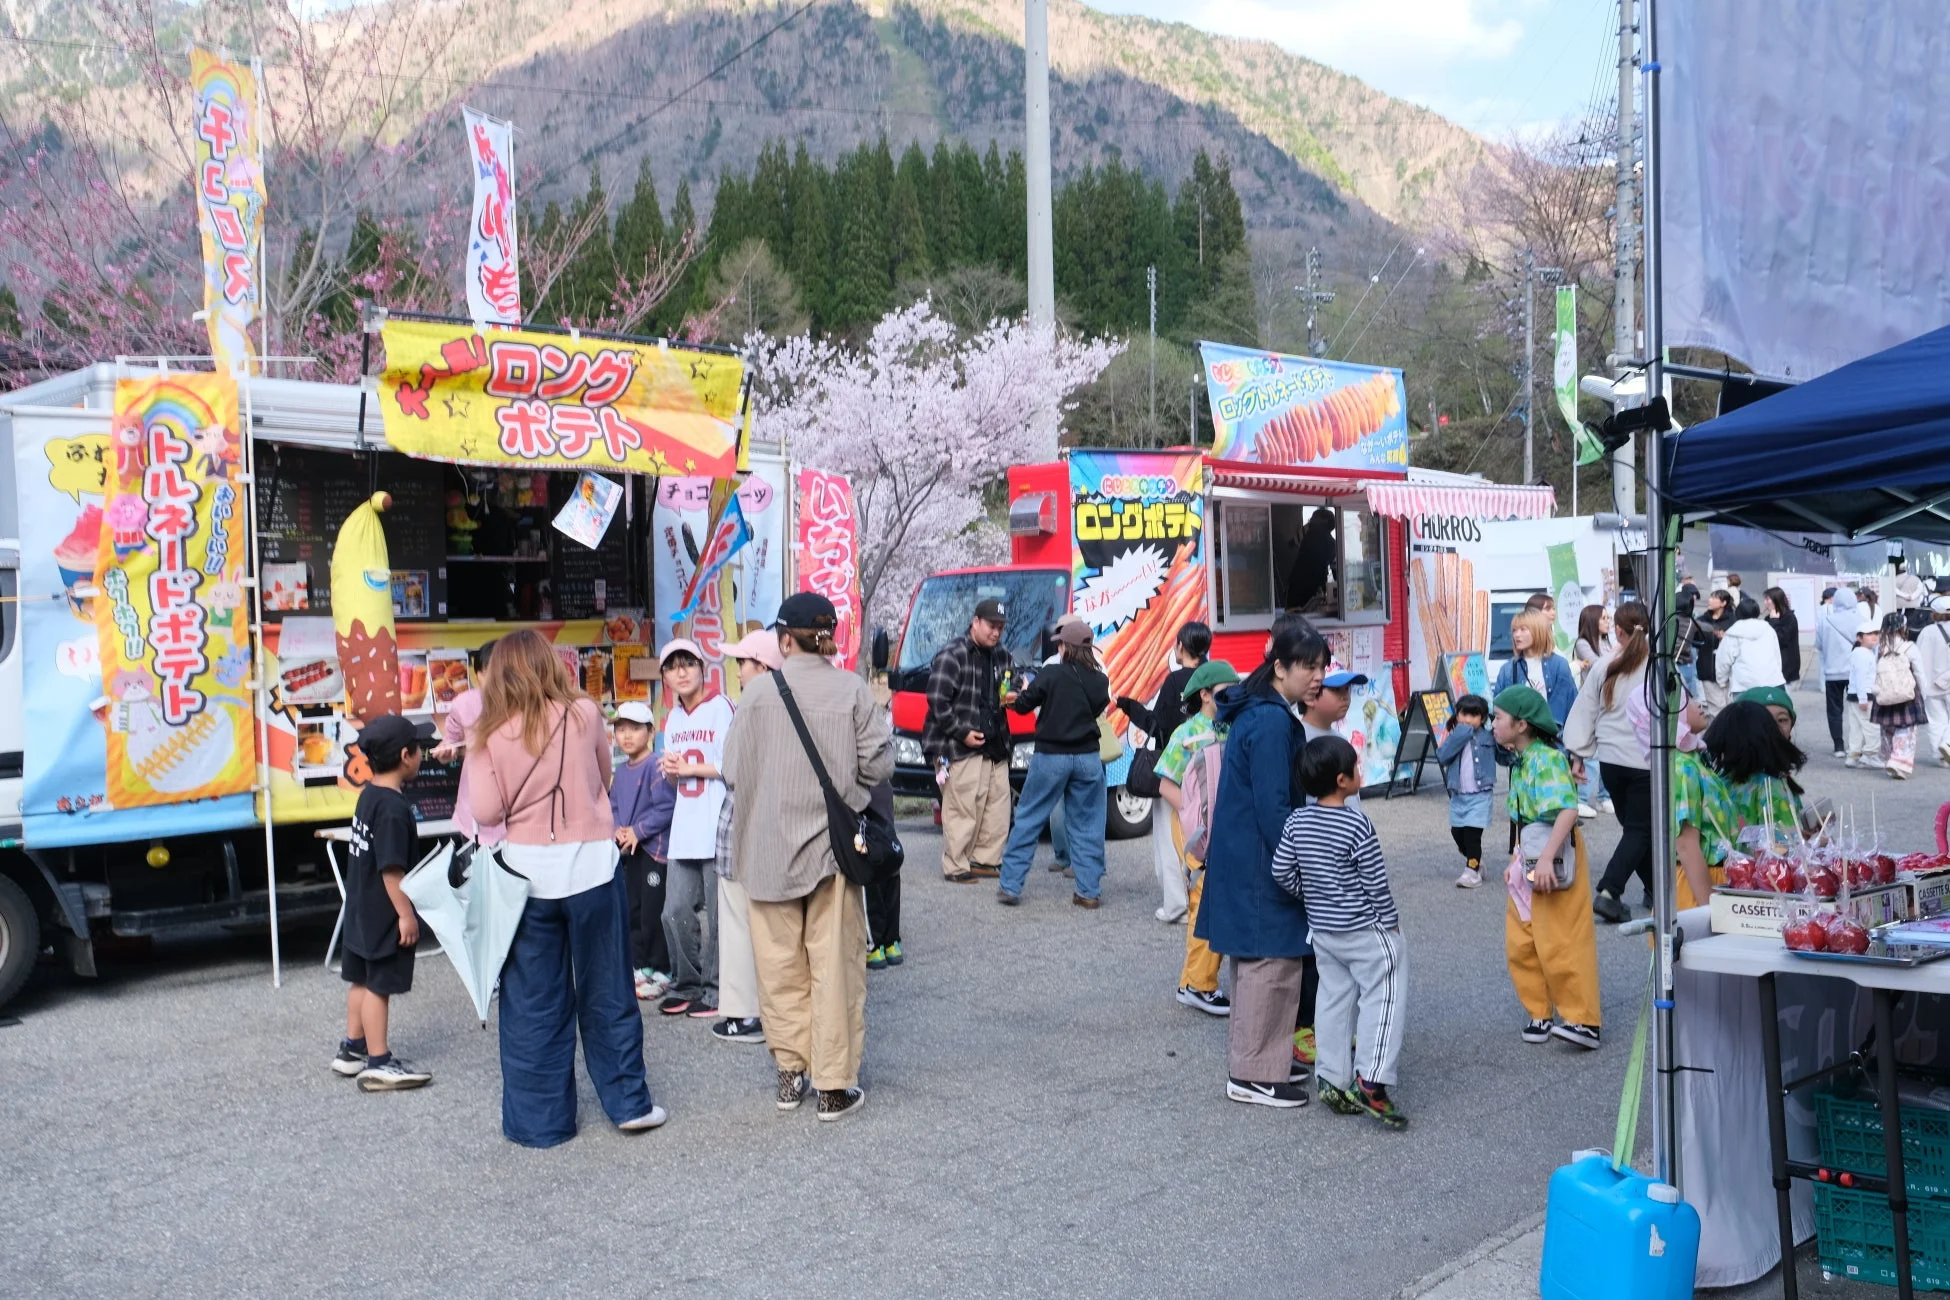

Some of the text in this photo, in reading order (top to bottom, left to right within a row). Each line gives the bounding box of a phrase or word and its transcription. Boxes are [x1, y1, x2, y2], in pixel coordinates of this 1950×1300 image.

[487, 342, 634, 407] ロング
[497, 401, 642, 461] ポテト
[1076, 502, 1203, 540] ロングポテト
[1413, 513, 1482, 542] CHURROS
[149, 429, 200, 719] トルネードポテト
[1919, 884, 1944, 900] CASSETTE
